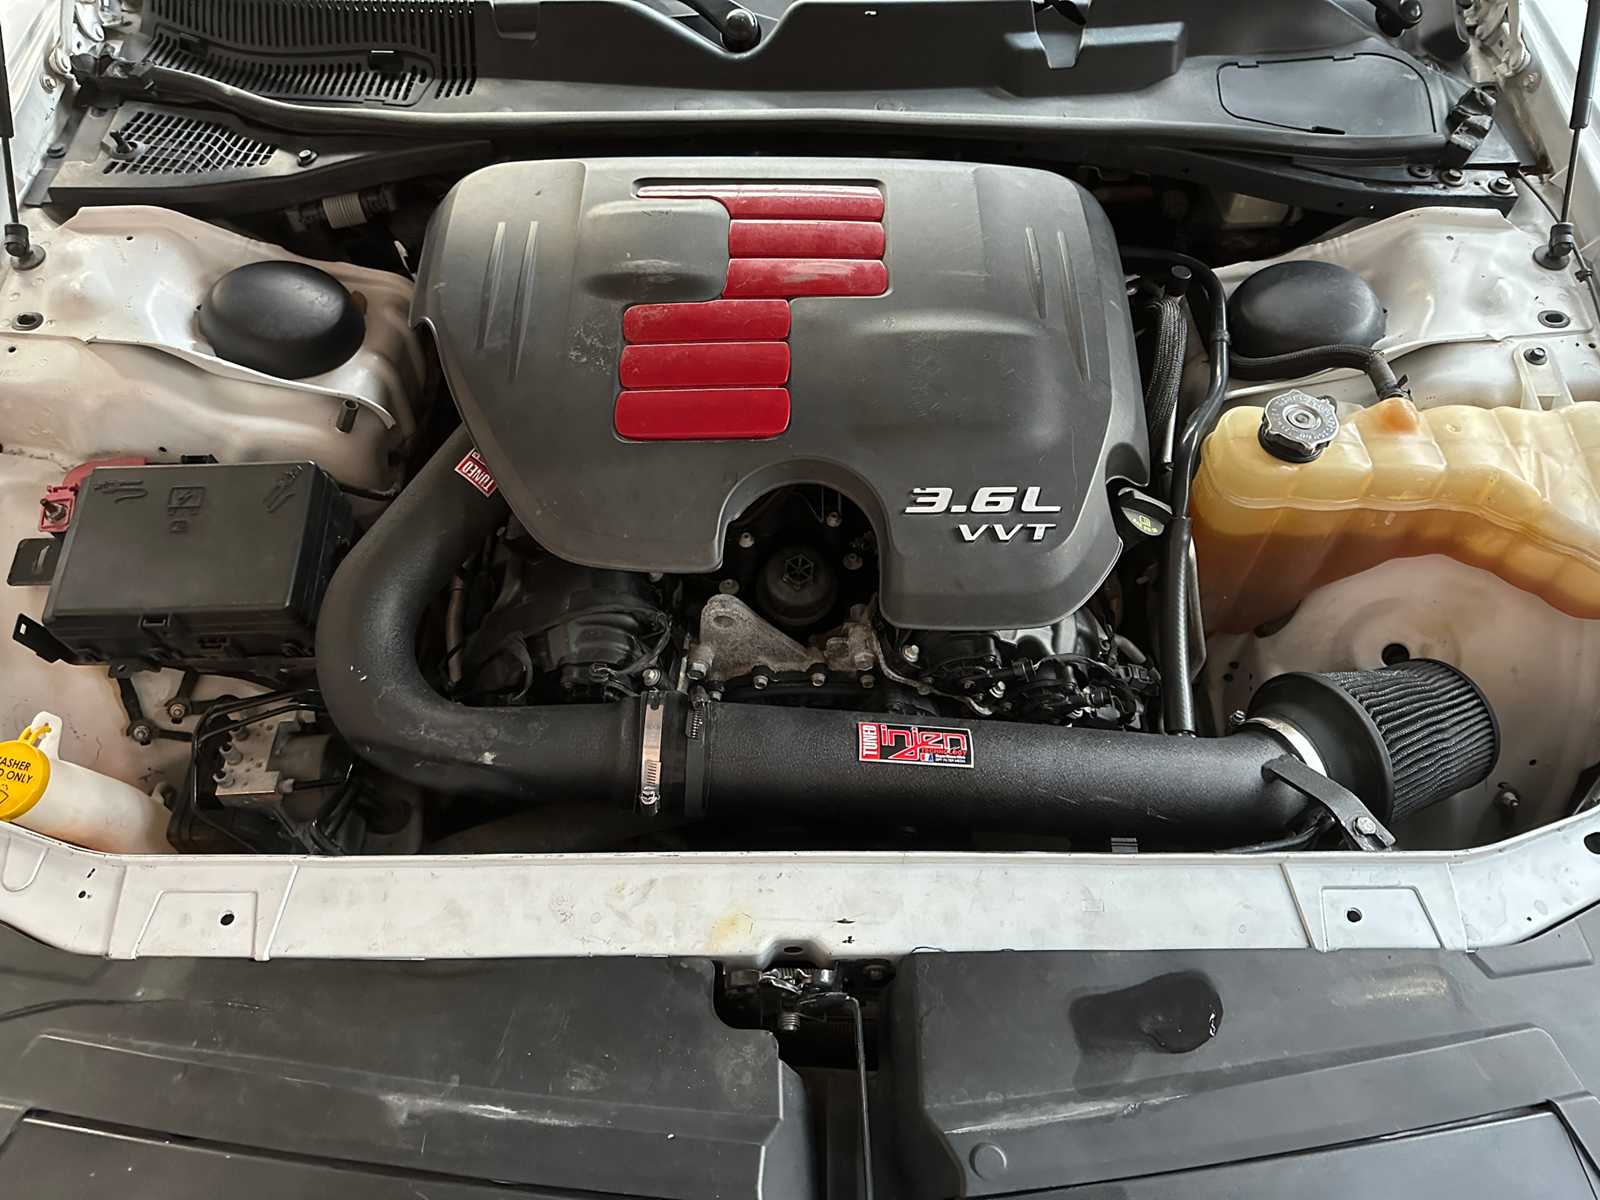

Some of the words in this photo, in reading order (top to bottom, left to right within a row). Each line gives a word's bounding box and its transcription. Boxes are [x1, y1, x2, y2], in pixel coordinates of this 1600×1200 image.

[462, 460, 495, 491] TUNED
[904, 486, 1062, 513] 3.6L
[957, 523, 1057, 541] VVT
[863, 724, 878, 756] TUNED
[880, 723, 968, 761] injen
[6, 770, 33, 784] ONLY
